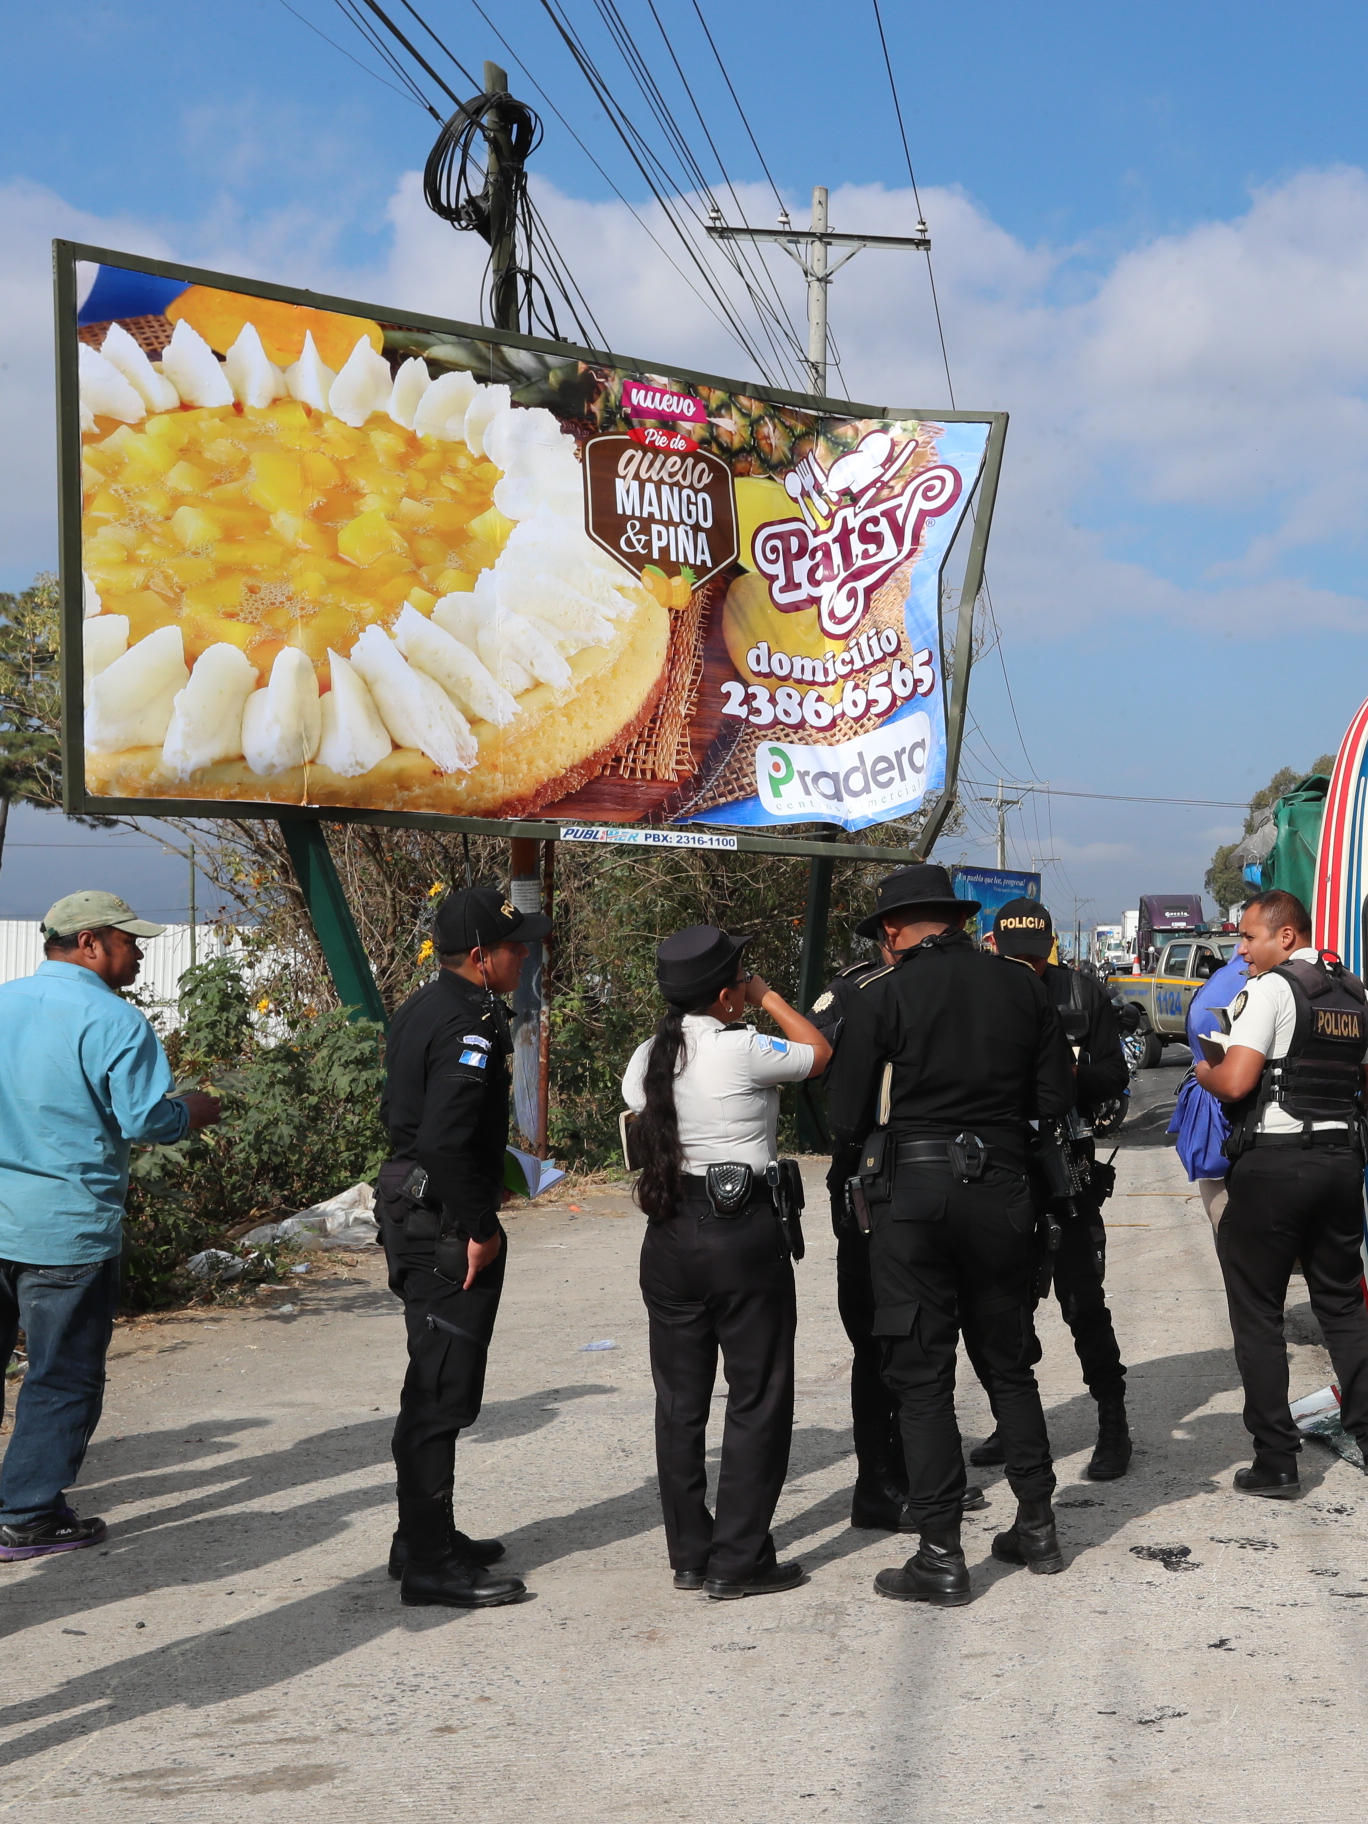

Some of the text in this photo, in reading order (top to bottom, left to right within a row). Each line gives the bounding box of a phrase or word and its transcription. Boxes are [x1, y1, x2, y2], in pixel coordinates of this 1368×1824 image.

[631, 388, 696, 417] nuevo
[644, 428, 687, 451] Pie de
[617, 449, 713, 490] queso
[615, 477, 713, 529] MANGO
[757, 470, 958, 632] Patsy
[746, 627, 899, 685] domicilio
[720, 649, 934, 728] 2386-6565
[768, 738, 926, 802] Pradera
[645, 832, 672, 844] PBX:
[676, 835, 736, 848] 2316-1100
[1000, 917, 1045, 931] POLICIA
[1157, 991, 1182, 1016] 1124
[1317, 1010, 1360, 1038] POLICIA
